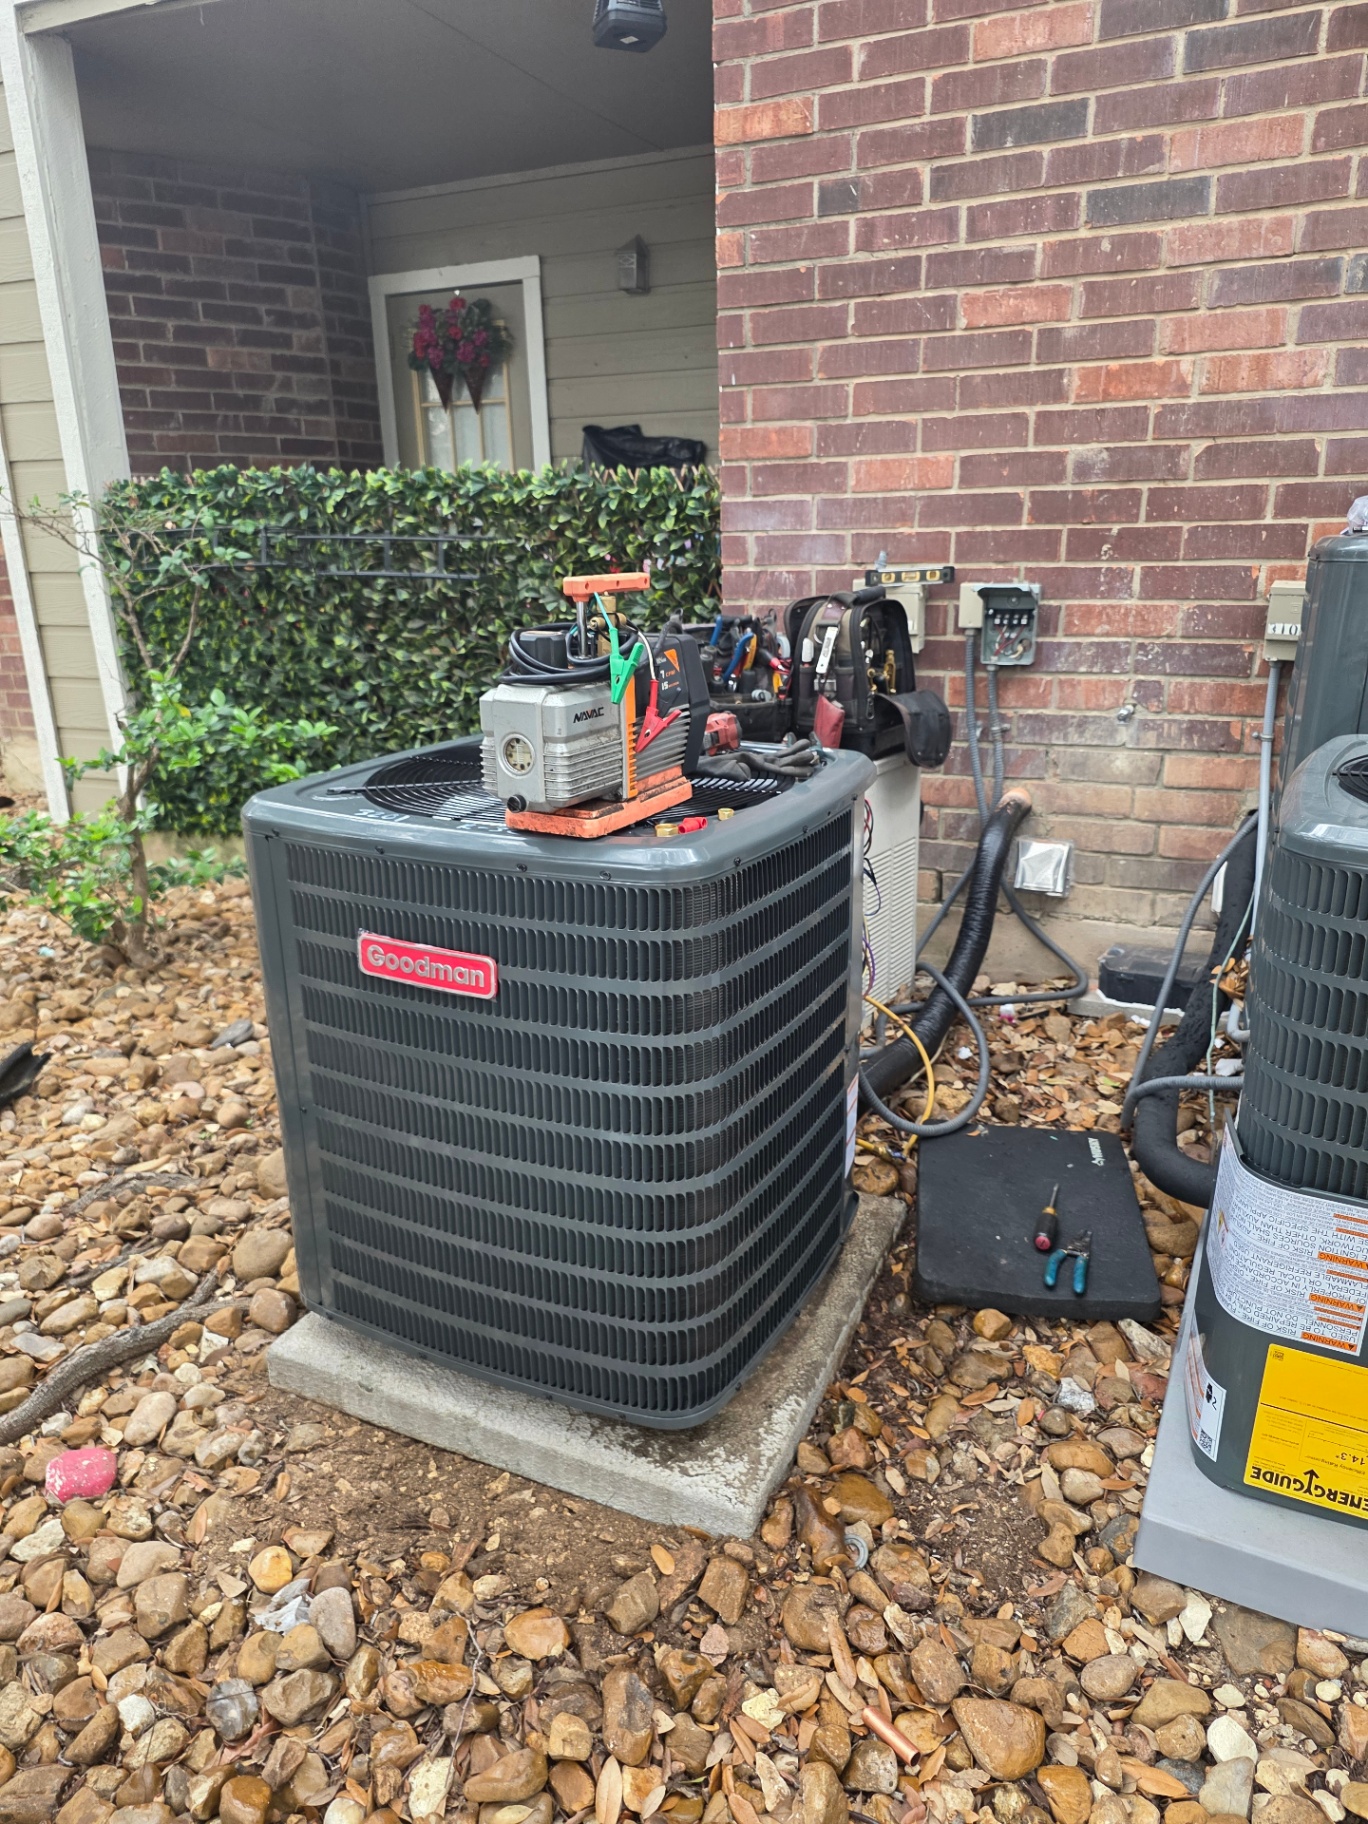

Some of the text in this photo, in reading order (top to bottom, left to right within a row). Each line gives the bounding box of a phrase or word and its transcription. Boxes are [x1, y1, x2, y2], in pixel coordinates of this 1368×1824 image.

[573, 706, 605, 723] NAVAC
[367, 944, 485, 988] Goodman
[1247, 1221, 1270, 1236] SHALL
[1260, 1221, 1283, 1234] THAN
[1269, 1216, 1309, 1232] SPECIFIC
[1285, 1229, 1317, 1242] OTHER
[1311, 1228, 1329, 1237] THE
[1331, 1232, 1356, 1243] WITH
[1257, 1234, 1276, 1246] FIRE
[1272, 1232, 1316, 1249] SOURCES
[1278, 1242, 1290, 1250] OF
[1292, 1246, 1313, 1256] RISK
[1318, 1244, 1359, 1259] IGNITION
[1251, 1253, 1312, 1276] REFRIGERANT
[1319, 1252, 1362, 1268] WARNING
[1235, 1259, 1289, 1286] ACCORDANCE
[1277, 1271, 1306, 1283] LOCAL
[1250, 1276, 1269, 1287] FIRE
[1270, 1283, 1283, 1292] OF
[1308, 1279, 1322, 1287] OR
[1314, 1271, 1368, 1290] FLAMMABLE
[1285, 1288, 1305, 1298] RISK
[1302, 1284, 1351, 1302] PROPERLY
[1326, 1283, 1367, 1298] FEDERAL
[1231, 1300, 1252, 1314] ONLY
[1310, 1294, 1354, 1310] WARNING
[1253, 1310, 1298, 1328] REPAIRED
[1264, 1308, 1284, 1318] NOT
[1285, 1313, 1299, 1322] DO
[1241, 1313, 1346, 1348] WARNING RISK OF FIRE
[1299, 1324, 1311, 1332] BE
[1313, 1327, 1325, 1335] TO
[1250, 1466, 1368, 1512] ENERGYGUIDE
